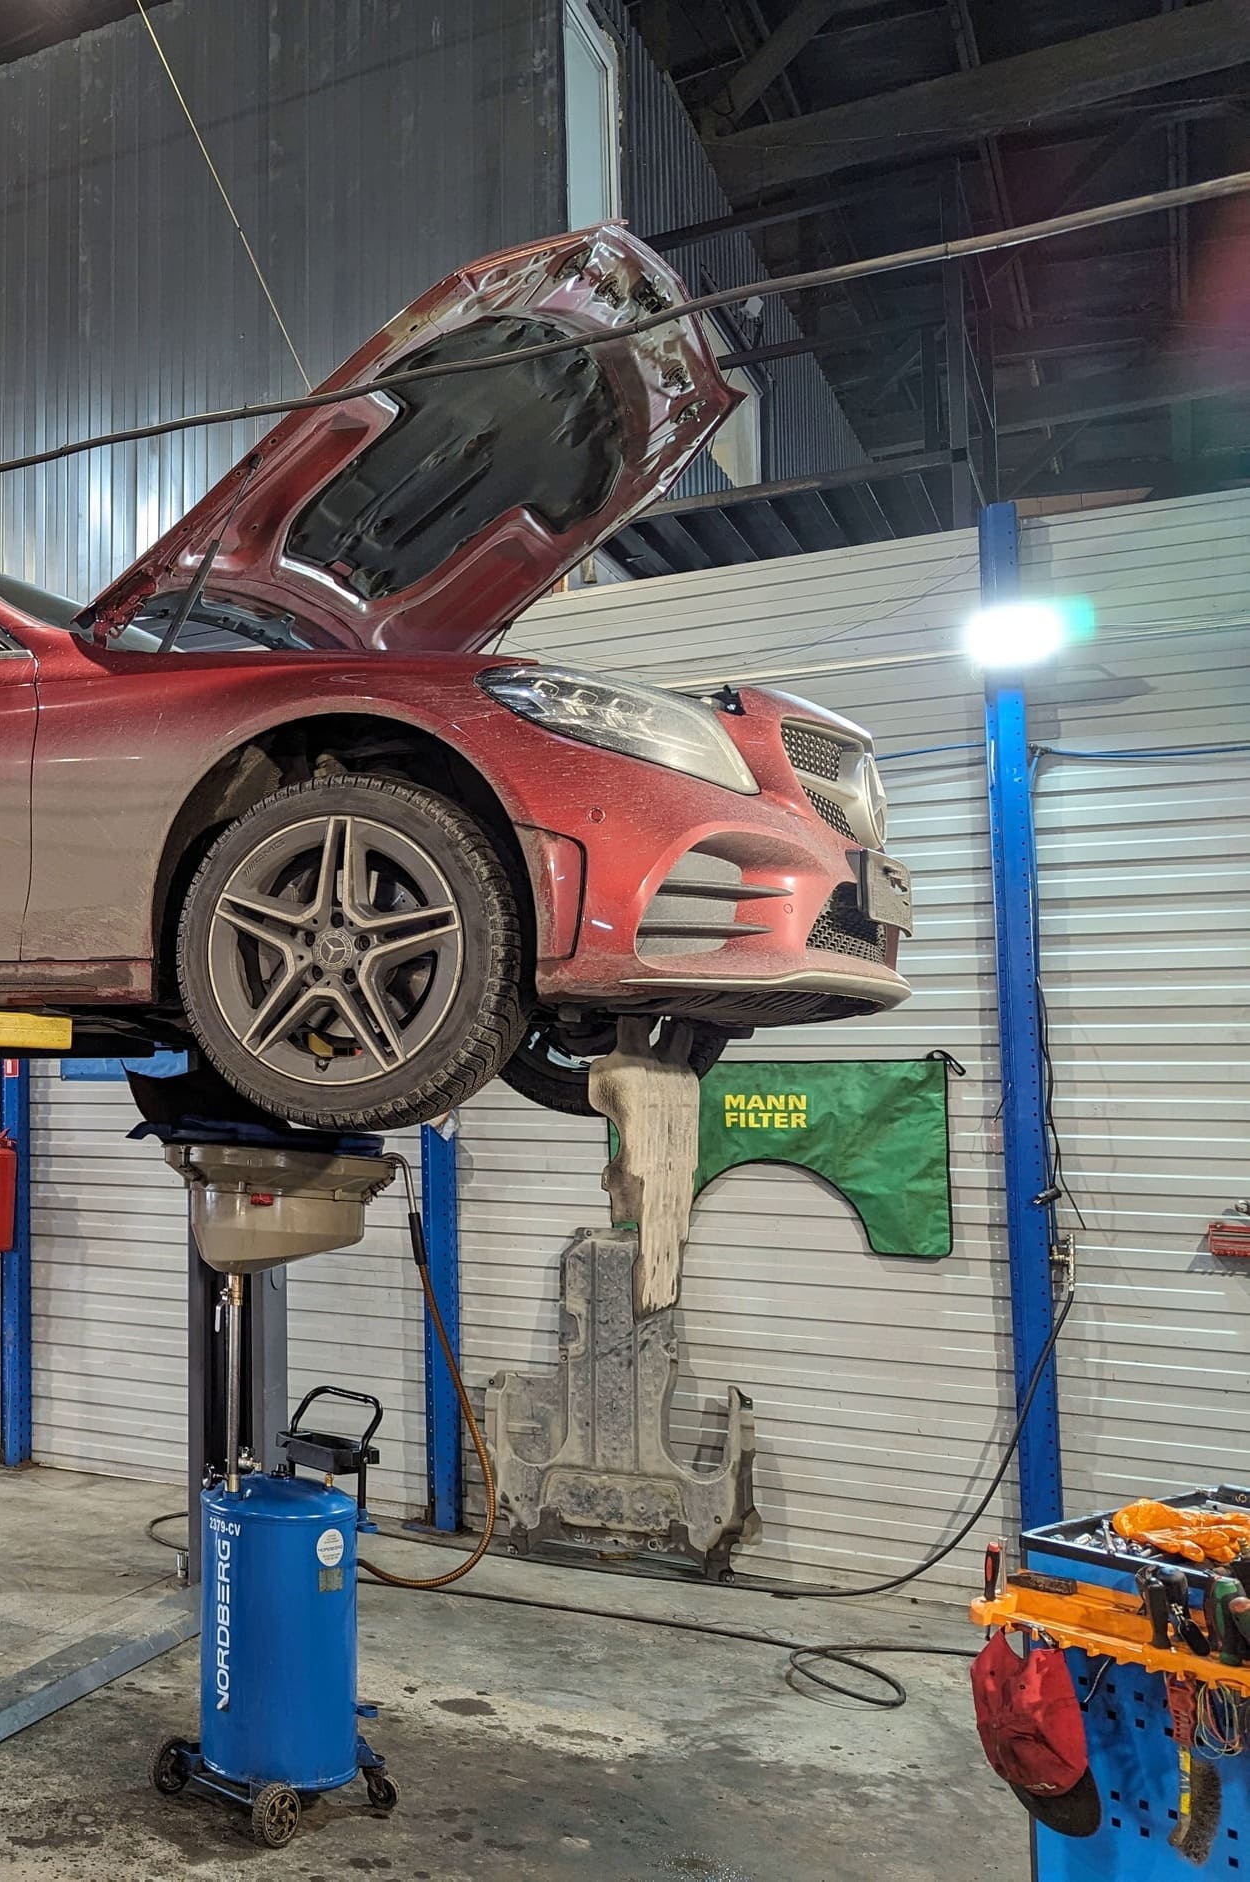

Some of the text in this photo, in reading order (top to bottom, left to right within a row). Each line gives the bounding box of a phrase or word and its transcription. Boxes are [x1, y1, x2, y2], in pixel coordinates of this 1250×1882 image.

[725, 1094, 807, 1110] MANN
[725, 1112, 808, 1128] FILTER
[209, 1516, 241, 1537] 2379-CV
[216, 1538, 231, 1710] NORDBERG
